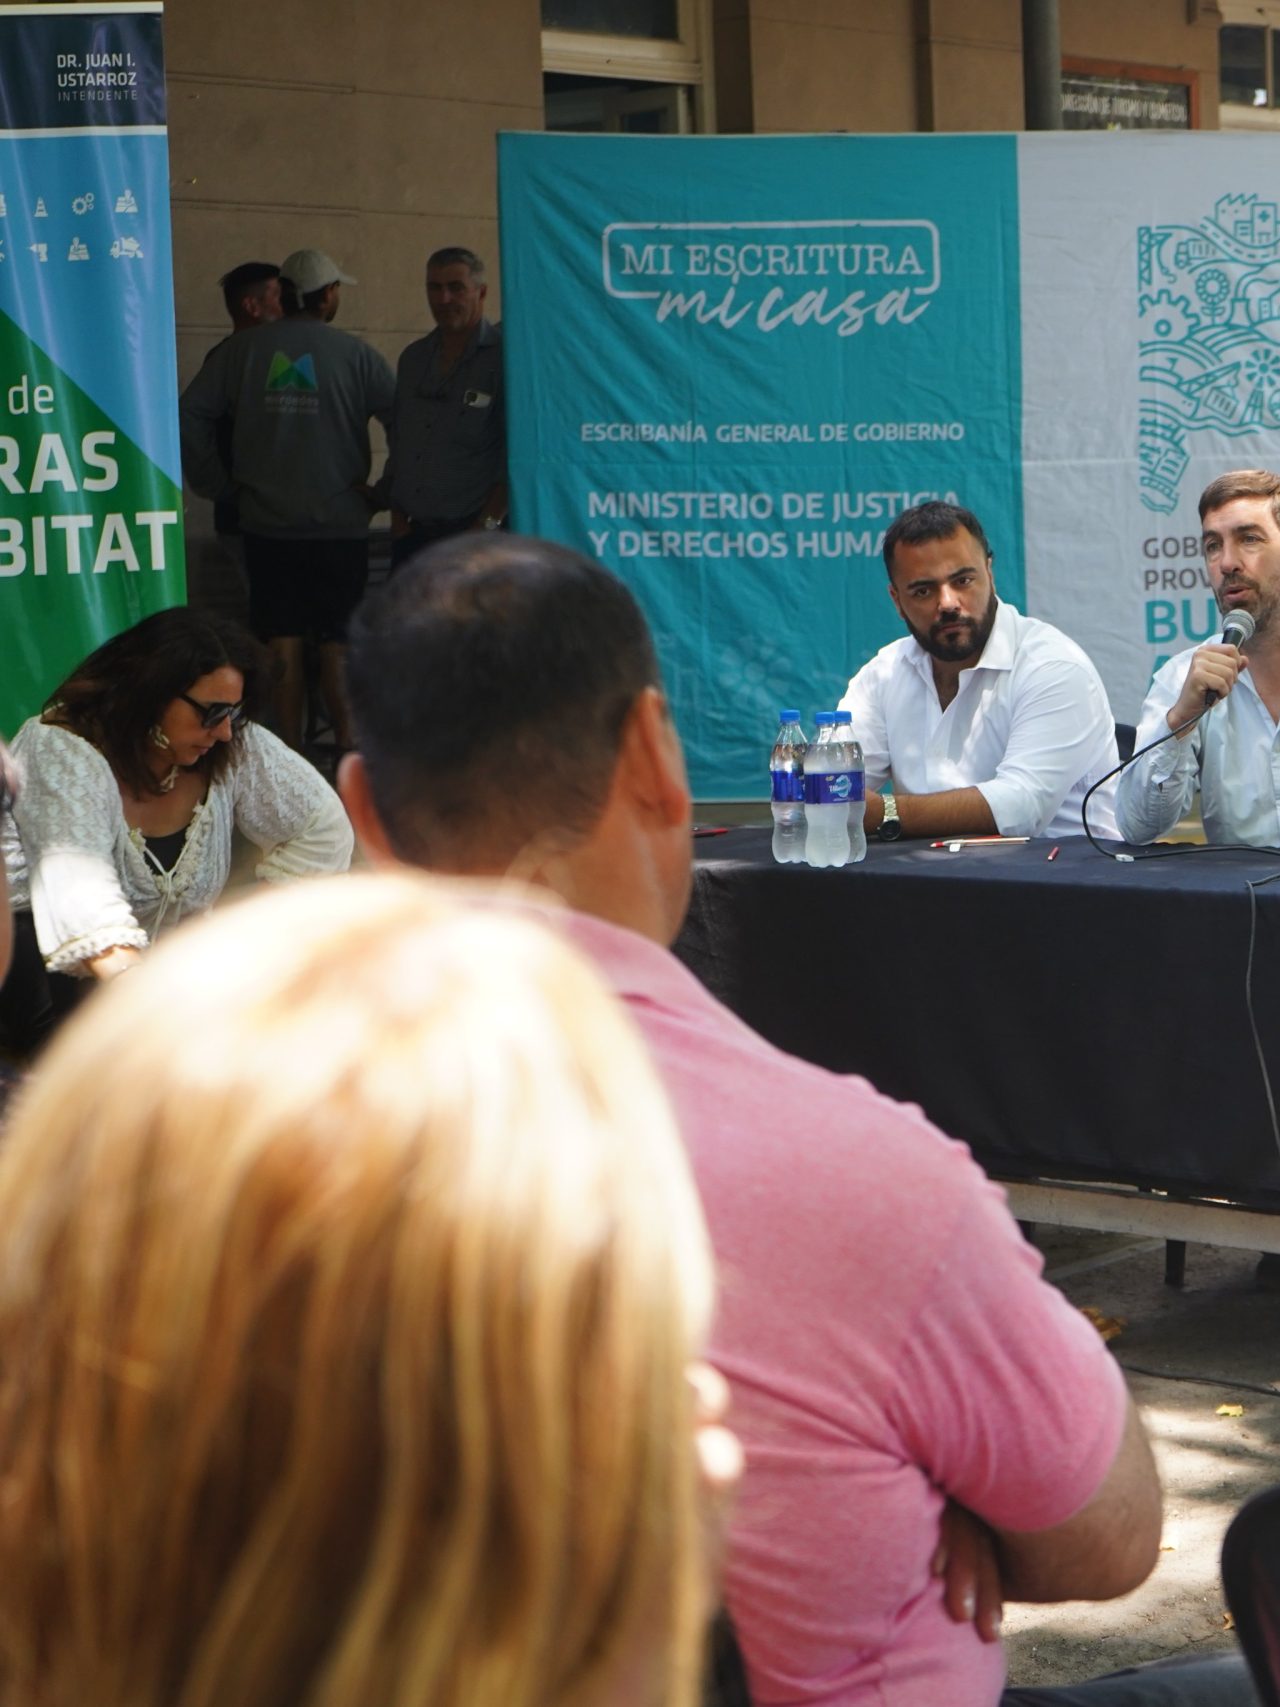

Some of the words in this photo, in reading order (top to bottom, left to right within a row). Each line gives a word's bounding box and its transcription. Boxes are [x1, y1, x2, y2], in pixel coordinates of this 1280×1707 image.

[57, 54, 82, 69] DR.
[86, 53, 122, 70] JUAN
[127, 53, 136, 67] I.
[57, 72, 137, 87] USTARROZ
[58, 89, 138, 102] INTENDENTE
[619, 244, 675, 276] MI
[685, 244, 925, 277] ESCRITURA
[655, 271, 753, 329] mi
[757, 286, 931, 337] casa
[8, 374, 55, 415] de
[580, 421, 708, 443] ESCRIBANÍA
[715, 424, 815, 443] GENERAL
[819, 423, 849, 442] DE
[853, 421, 965, 442] GOBIERNO
[588, 491, 774, 519] MINISTERIO
[782, 492, 825, 519] DE
[588, 531, 610, 557] Y
[618, 530, 788, 558] DERECHOS
